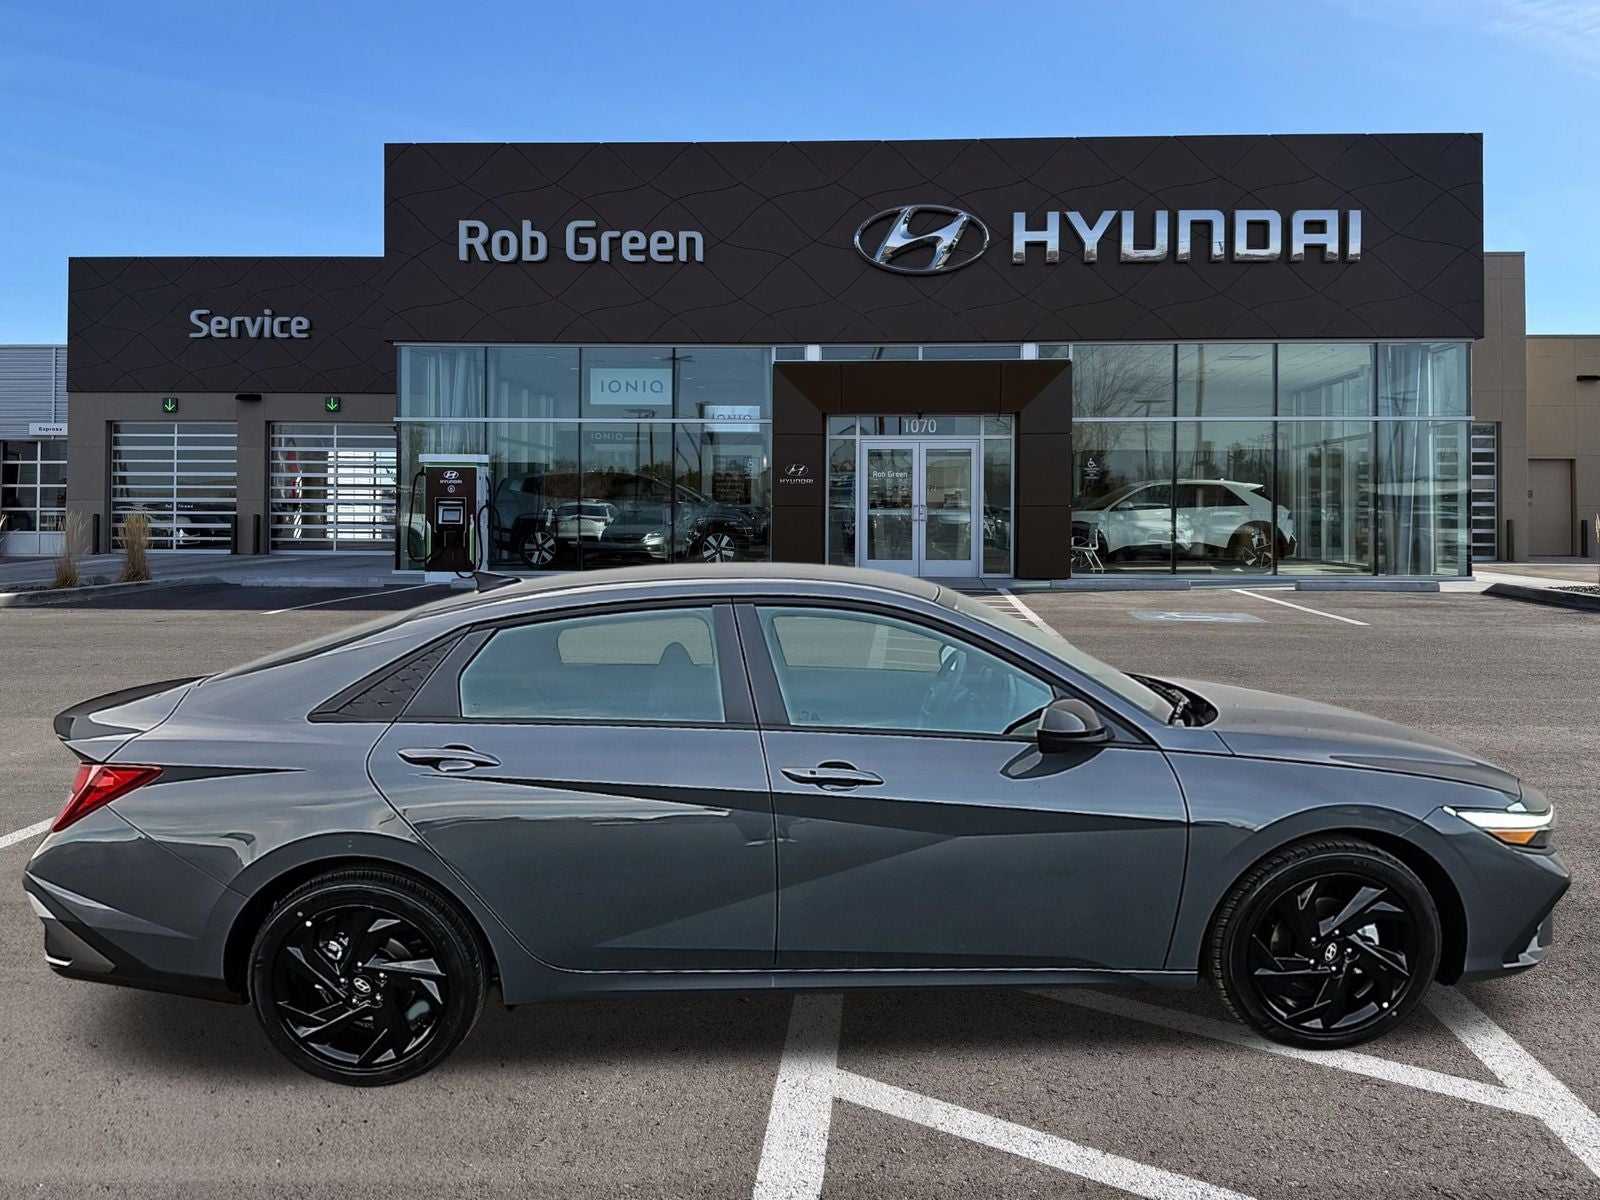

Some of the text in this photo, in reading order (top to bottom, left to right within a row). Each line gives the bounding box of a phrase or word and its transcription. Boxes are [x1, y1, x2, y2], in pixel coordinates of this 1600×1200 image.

[458, 219, 705, 264] Rob Green
[1011, 209, 1362, 264] HYUNDAI
[189, 309, 310, 340] Service
[600, 379, 664, 394] IONIQ
[903, 419, 937, 433] 1070
[591, 432, 624, 441] IONIQ
[872, 470, 908, 478] Rob Green
